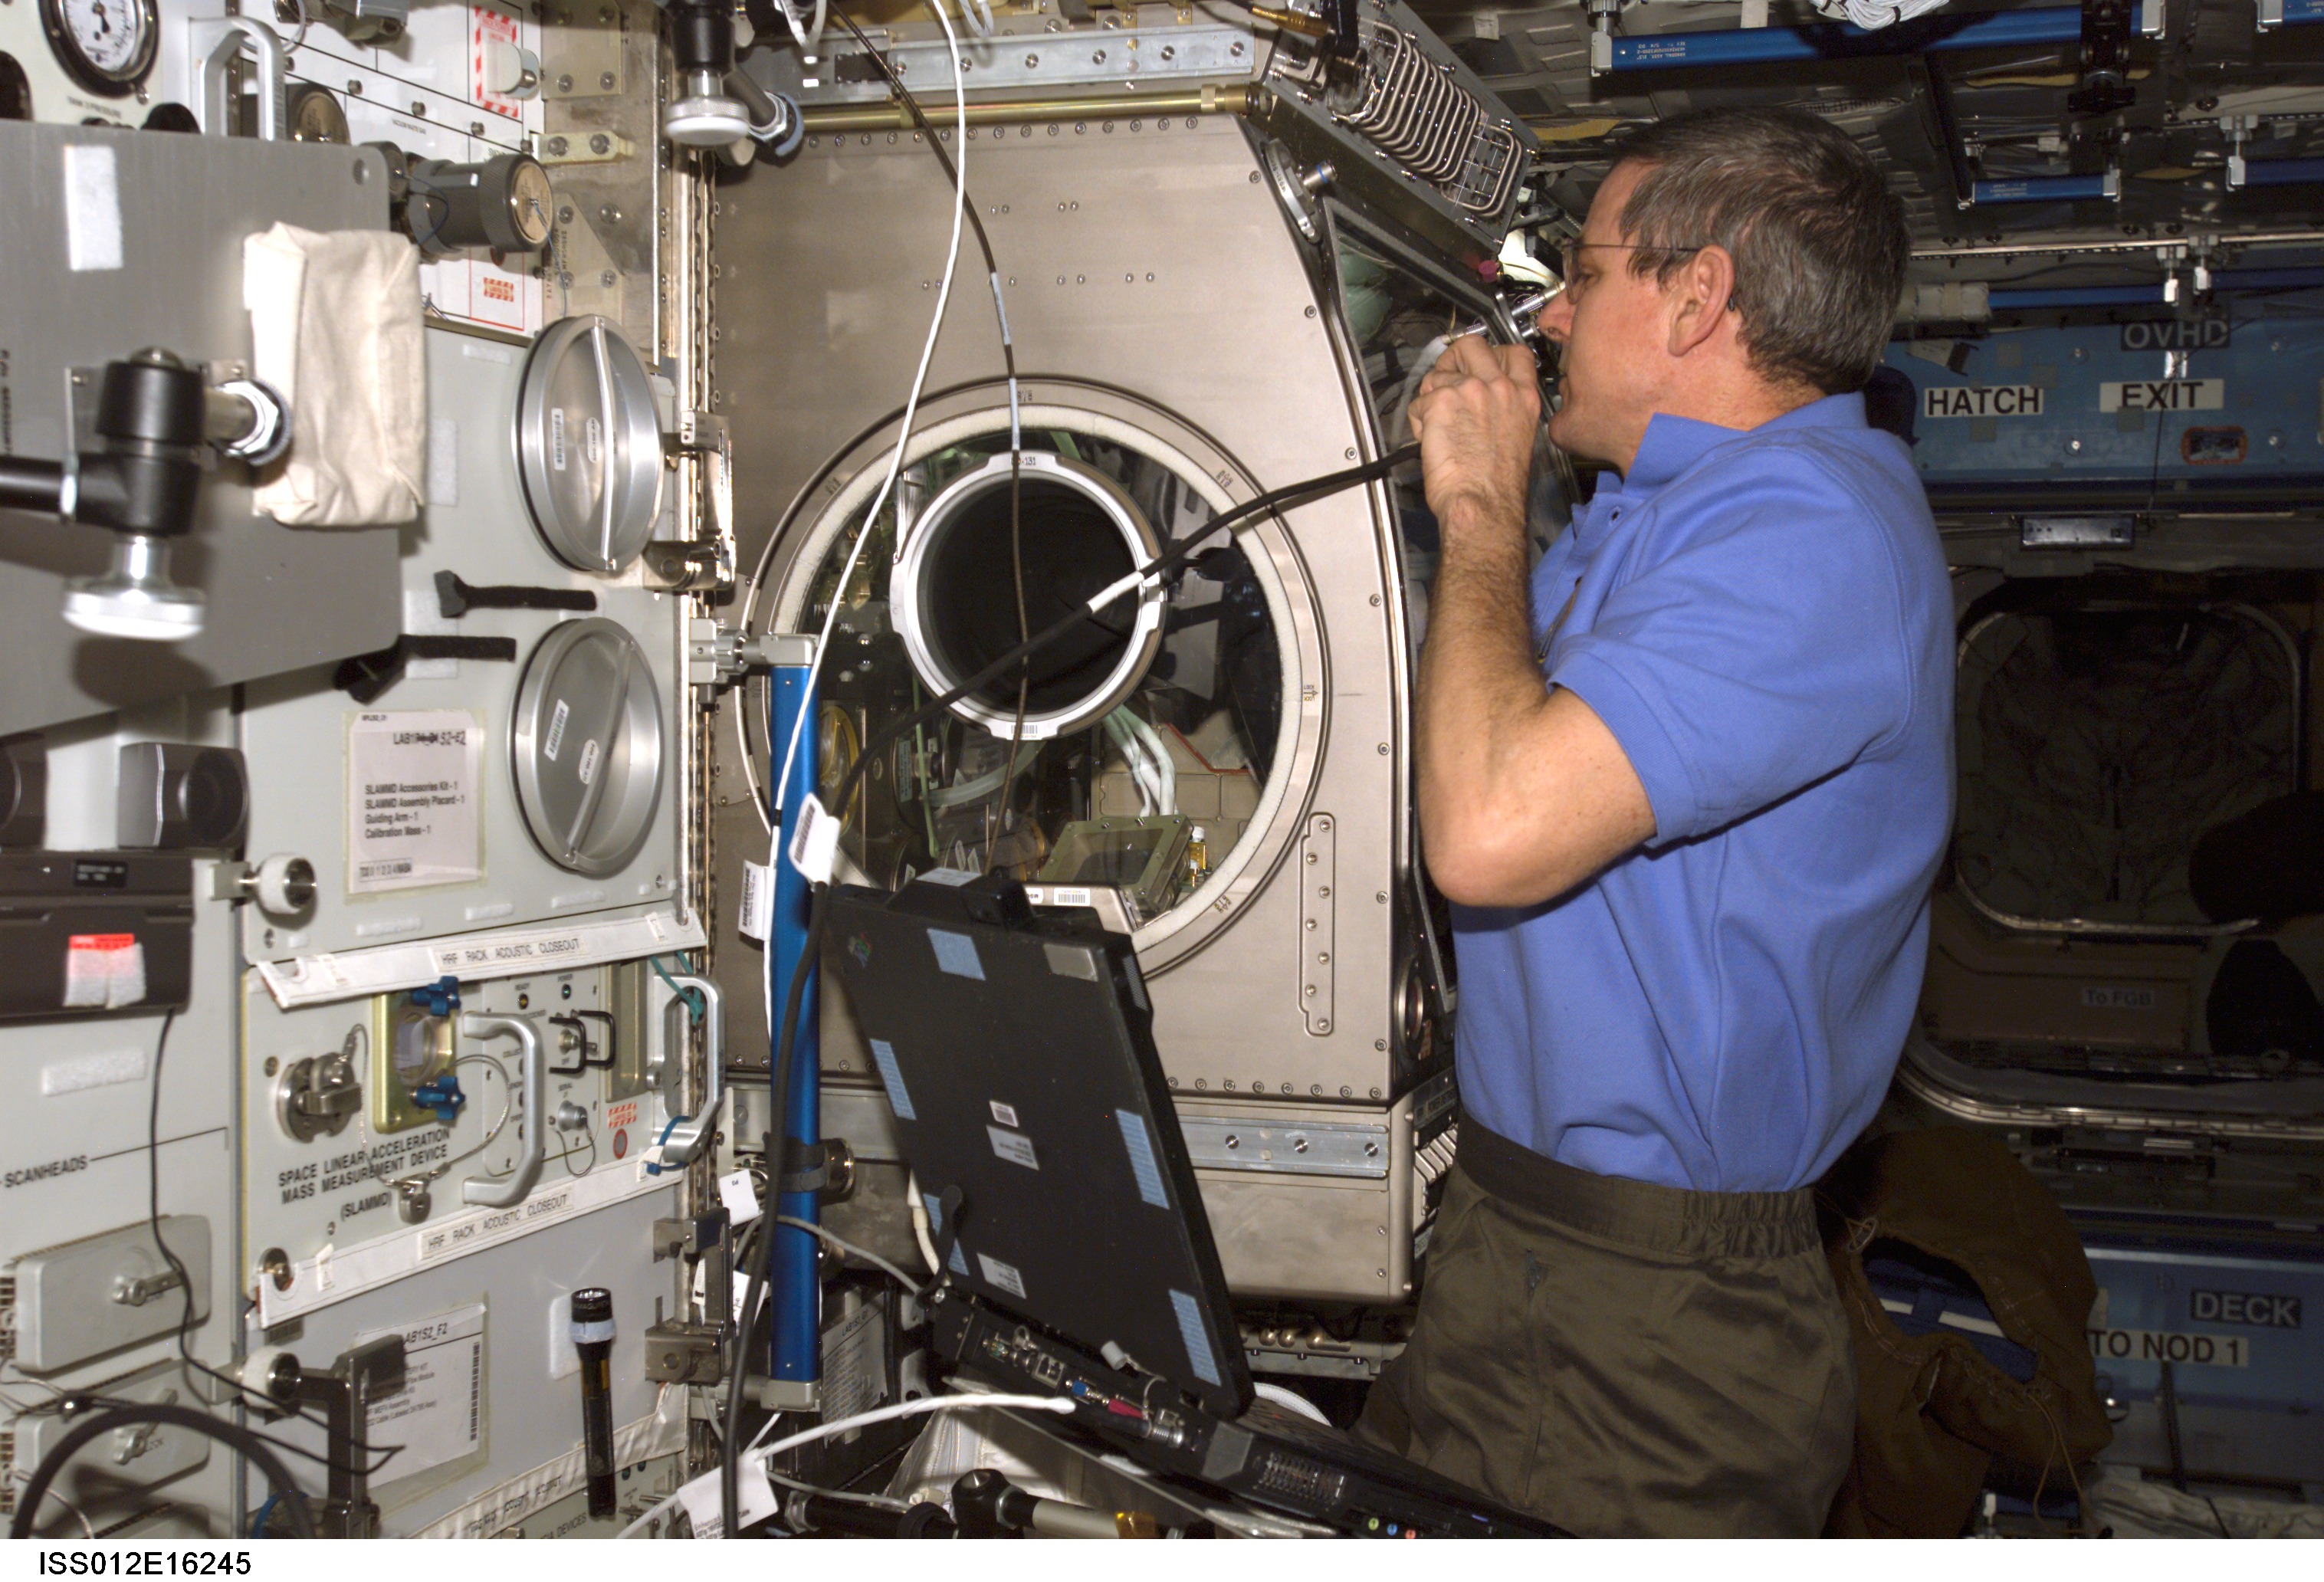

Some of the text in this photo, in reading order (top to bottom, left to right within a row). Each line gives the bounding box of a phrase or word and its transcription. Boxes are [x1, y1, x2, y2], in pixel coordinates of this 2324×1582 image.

[2123, 320, 2229, 350] OVHD
[1927, 386, 2040, 416] HATCH
[2121, 381, 2204, 411] EXIT
[399, 782, 438, 793] Accessories
[439, 781, 448, 791] Kit
[399, 796, 430, 808] Assembly
[432, 795, 455, 805] Placard
[365, 812, 392, 825] Guiding
[395, 812, 409, 822] Arm
[365, 827, 402, 839] Calibration
[404, 825, 421, 835] Mass
[441, 938, 580, 965] HRF RACK ACOUSTIC CLOSEOUT
[5, 1154, 89, 1188] SCANHEADS
[278, 1127, 451, 1186] SPACE LINEAR ACCELERATION
[281, 1144, 448, 1204] MASS MEASUREMENT DEVICE
[340, 1191, 392, 1221] (SLAMMD)
[428, 1193, 567, 1249] HRF RACK ACOUSTIC CLOSEOUT
[2194, 1292, 2299, 1328] DECK
[404, 1322, 448, 1344] AB1S2_F2
[2092, 1329, 2240, 1367] TO NOD 1
[556, 1511, 588, 1538] DEVICES
